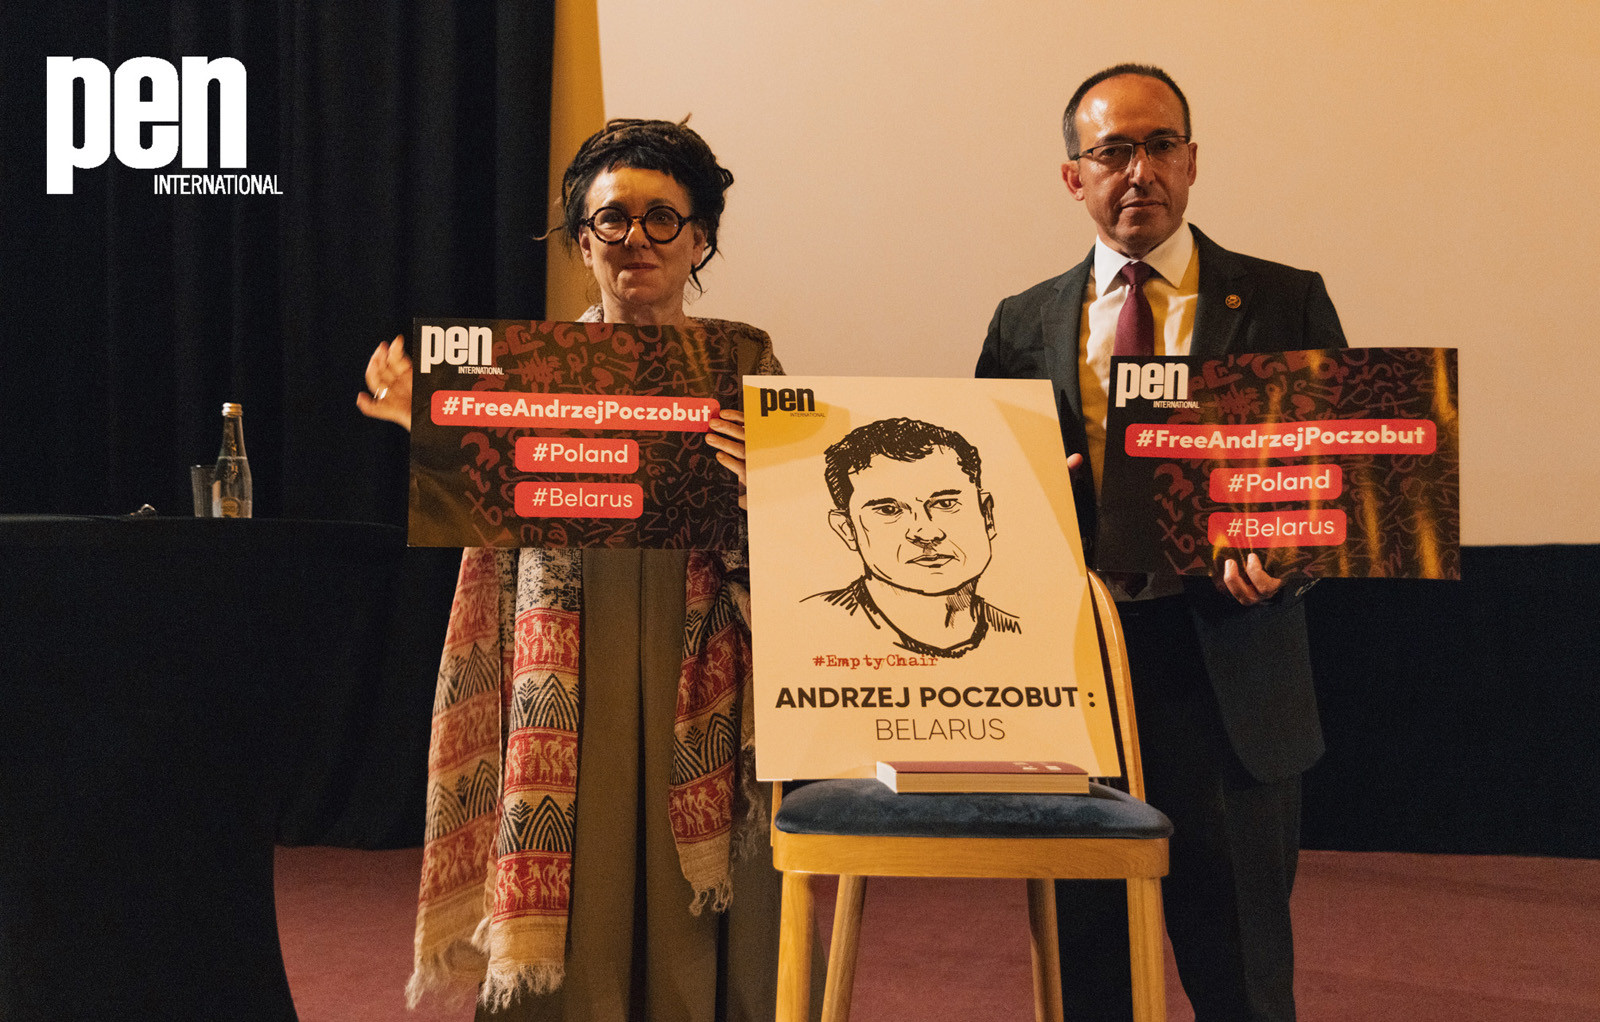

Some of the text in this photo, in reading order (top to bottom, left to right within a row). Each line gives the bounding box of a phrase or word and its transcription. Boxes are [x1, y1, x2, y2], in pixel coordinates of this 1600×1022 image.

[420, 325, 493, 374] pen
[458, 366, 505, 376] INTERNATIONAL
[1115, 362, 1189, 408] pen
[441, 396, 711, 424] #FreeAndrzejPoczobut
[759, 388, 816, 417] pen
[1153, 400, 1200, 409] INTERNATIONAL
[1136, 425, 1426, 452] #FreeAndrzejPoczobut
[532, 443, 629, 464] #Poland
[1227, 469, 1330, 493] #Poland
[532, 487, 634, 508] #Belarus
[1226, 517, 1335, 538] #Belarus
[775, 687, 911, 709] ANDRZEJ
[920, 686, 1079, 709] POCZOBUT
[875, 718, 1006, 741] BELARUS
